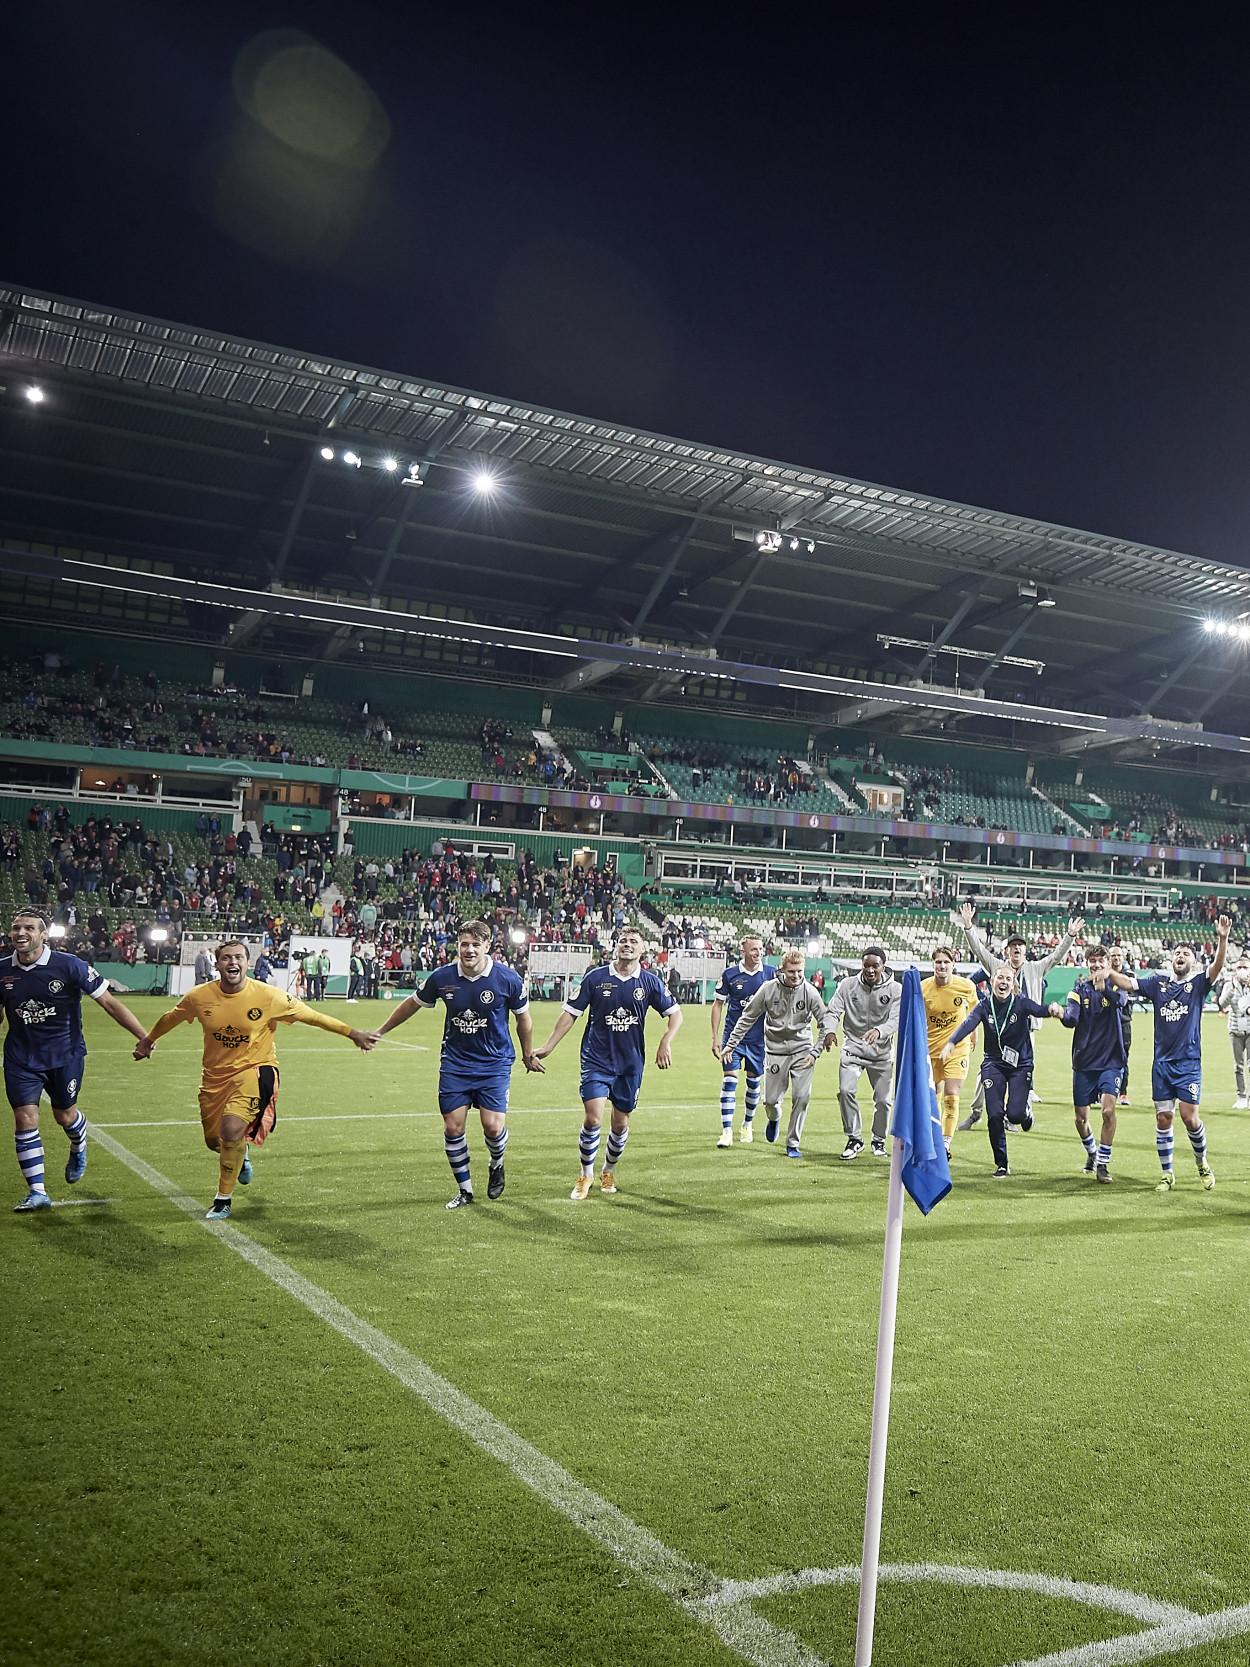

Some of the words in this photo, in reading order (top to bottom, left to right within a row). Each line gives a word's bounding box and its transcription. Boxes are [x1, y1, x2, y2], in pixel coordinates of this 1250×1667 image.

[339, 788, 349, 796] 48
[15, 1006, 57, 1019] Bauck
[1160, 1005, 1189, 1017] Bauck
[23, 1017, 46, 1025] HOF
[451, 1018, 488, 1028] Bauck
[605, 1015, 639, 1026] Bauck
[1165, 1014, 1182, 1022] HOF
[612, 1024, 630, 1032] HOF
[213, 1032, 250, 1044] Bauck
